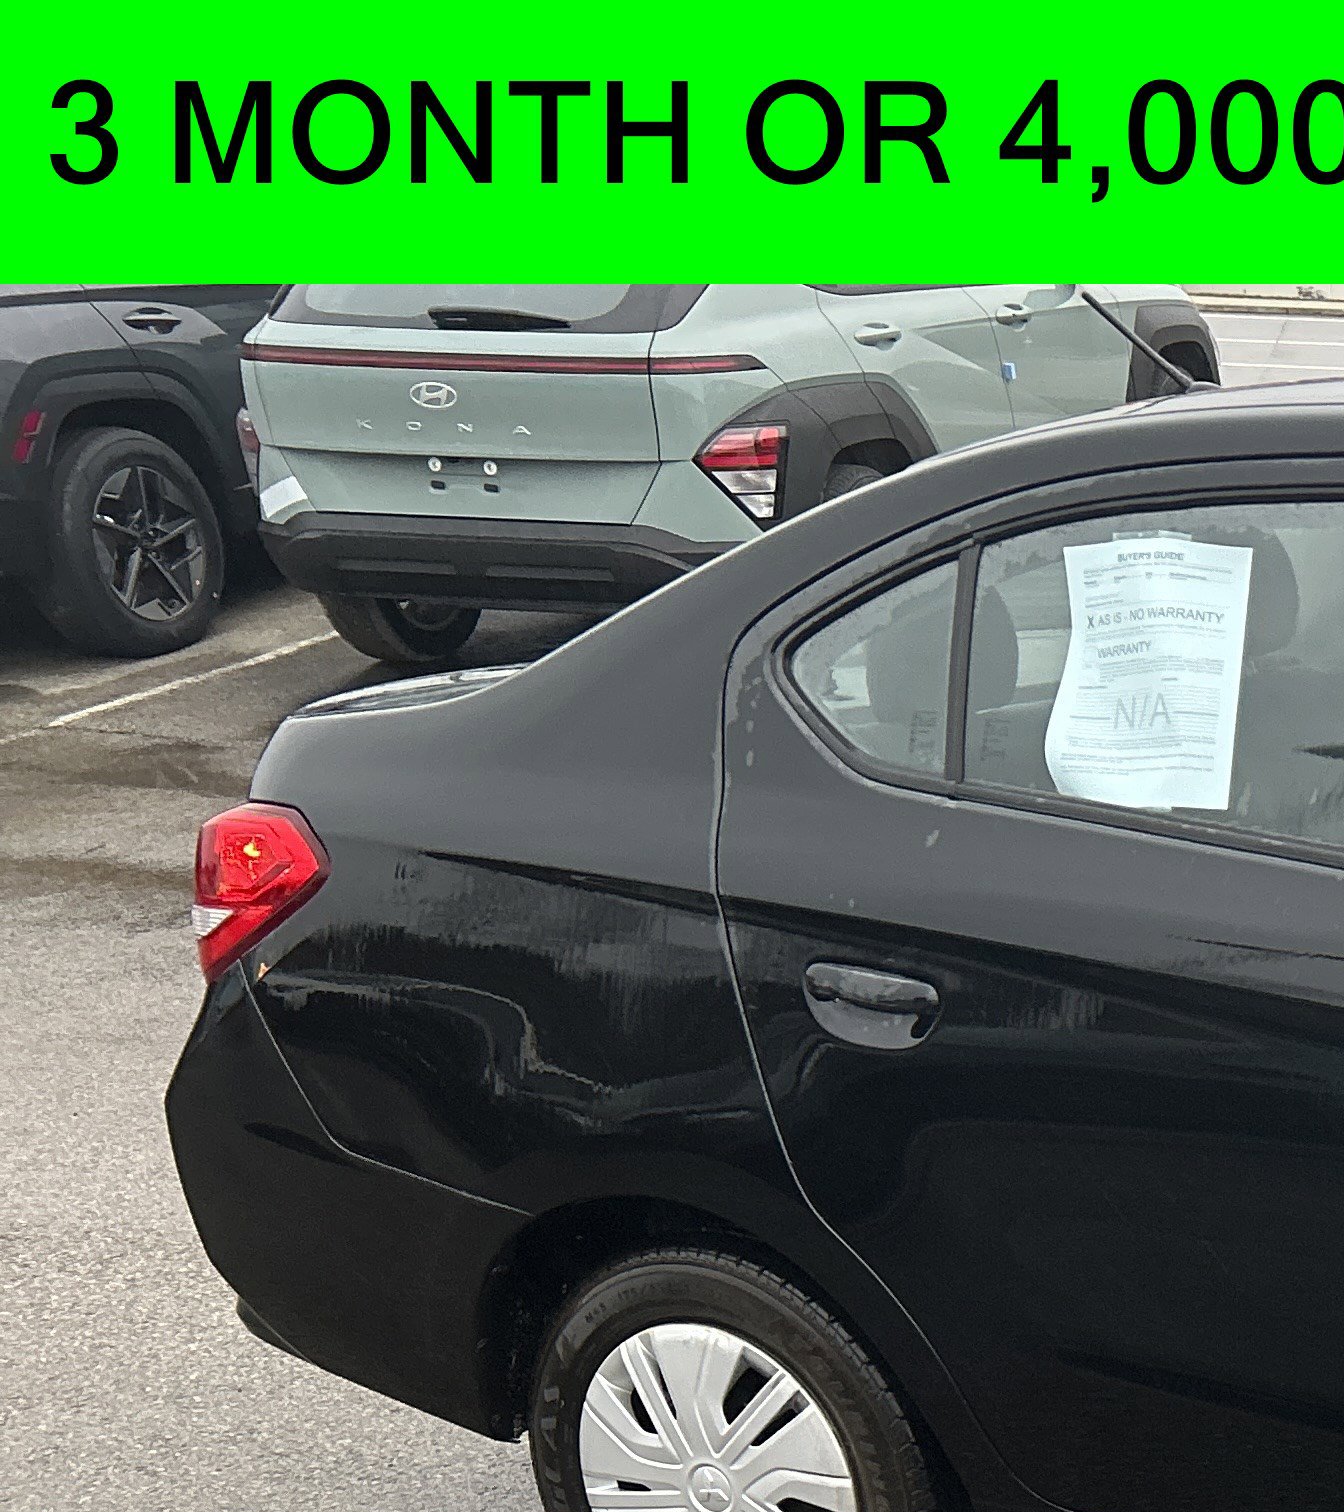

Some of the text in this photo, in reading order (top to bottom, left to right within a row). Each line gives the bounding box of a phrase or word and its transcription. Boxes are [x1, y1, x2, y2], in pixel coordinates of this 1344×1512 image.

[356, 418, 532, 436] KONA
[1153, 550, 1185, 561] GUIDE
[1087, 615, 1095, 629] X
[1098, 613, 1111, 626] AS
[1113, 612, 1122, 624] IS
[1129, 608, 1145, 622] NO
[1147, 606, 1225, 624] WARRANTY
[1098, 640, 1152, 659] WARRANTY
[1114, 692, 1171, 730] N/A
